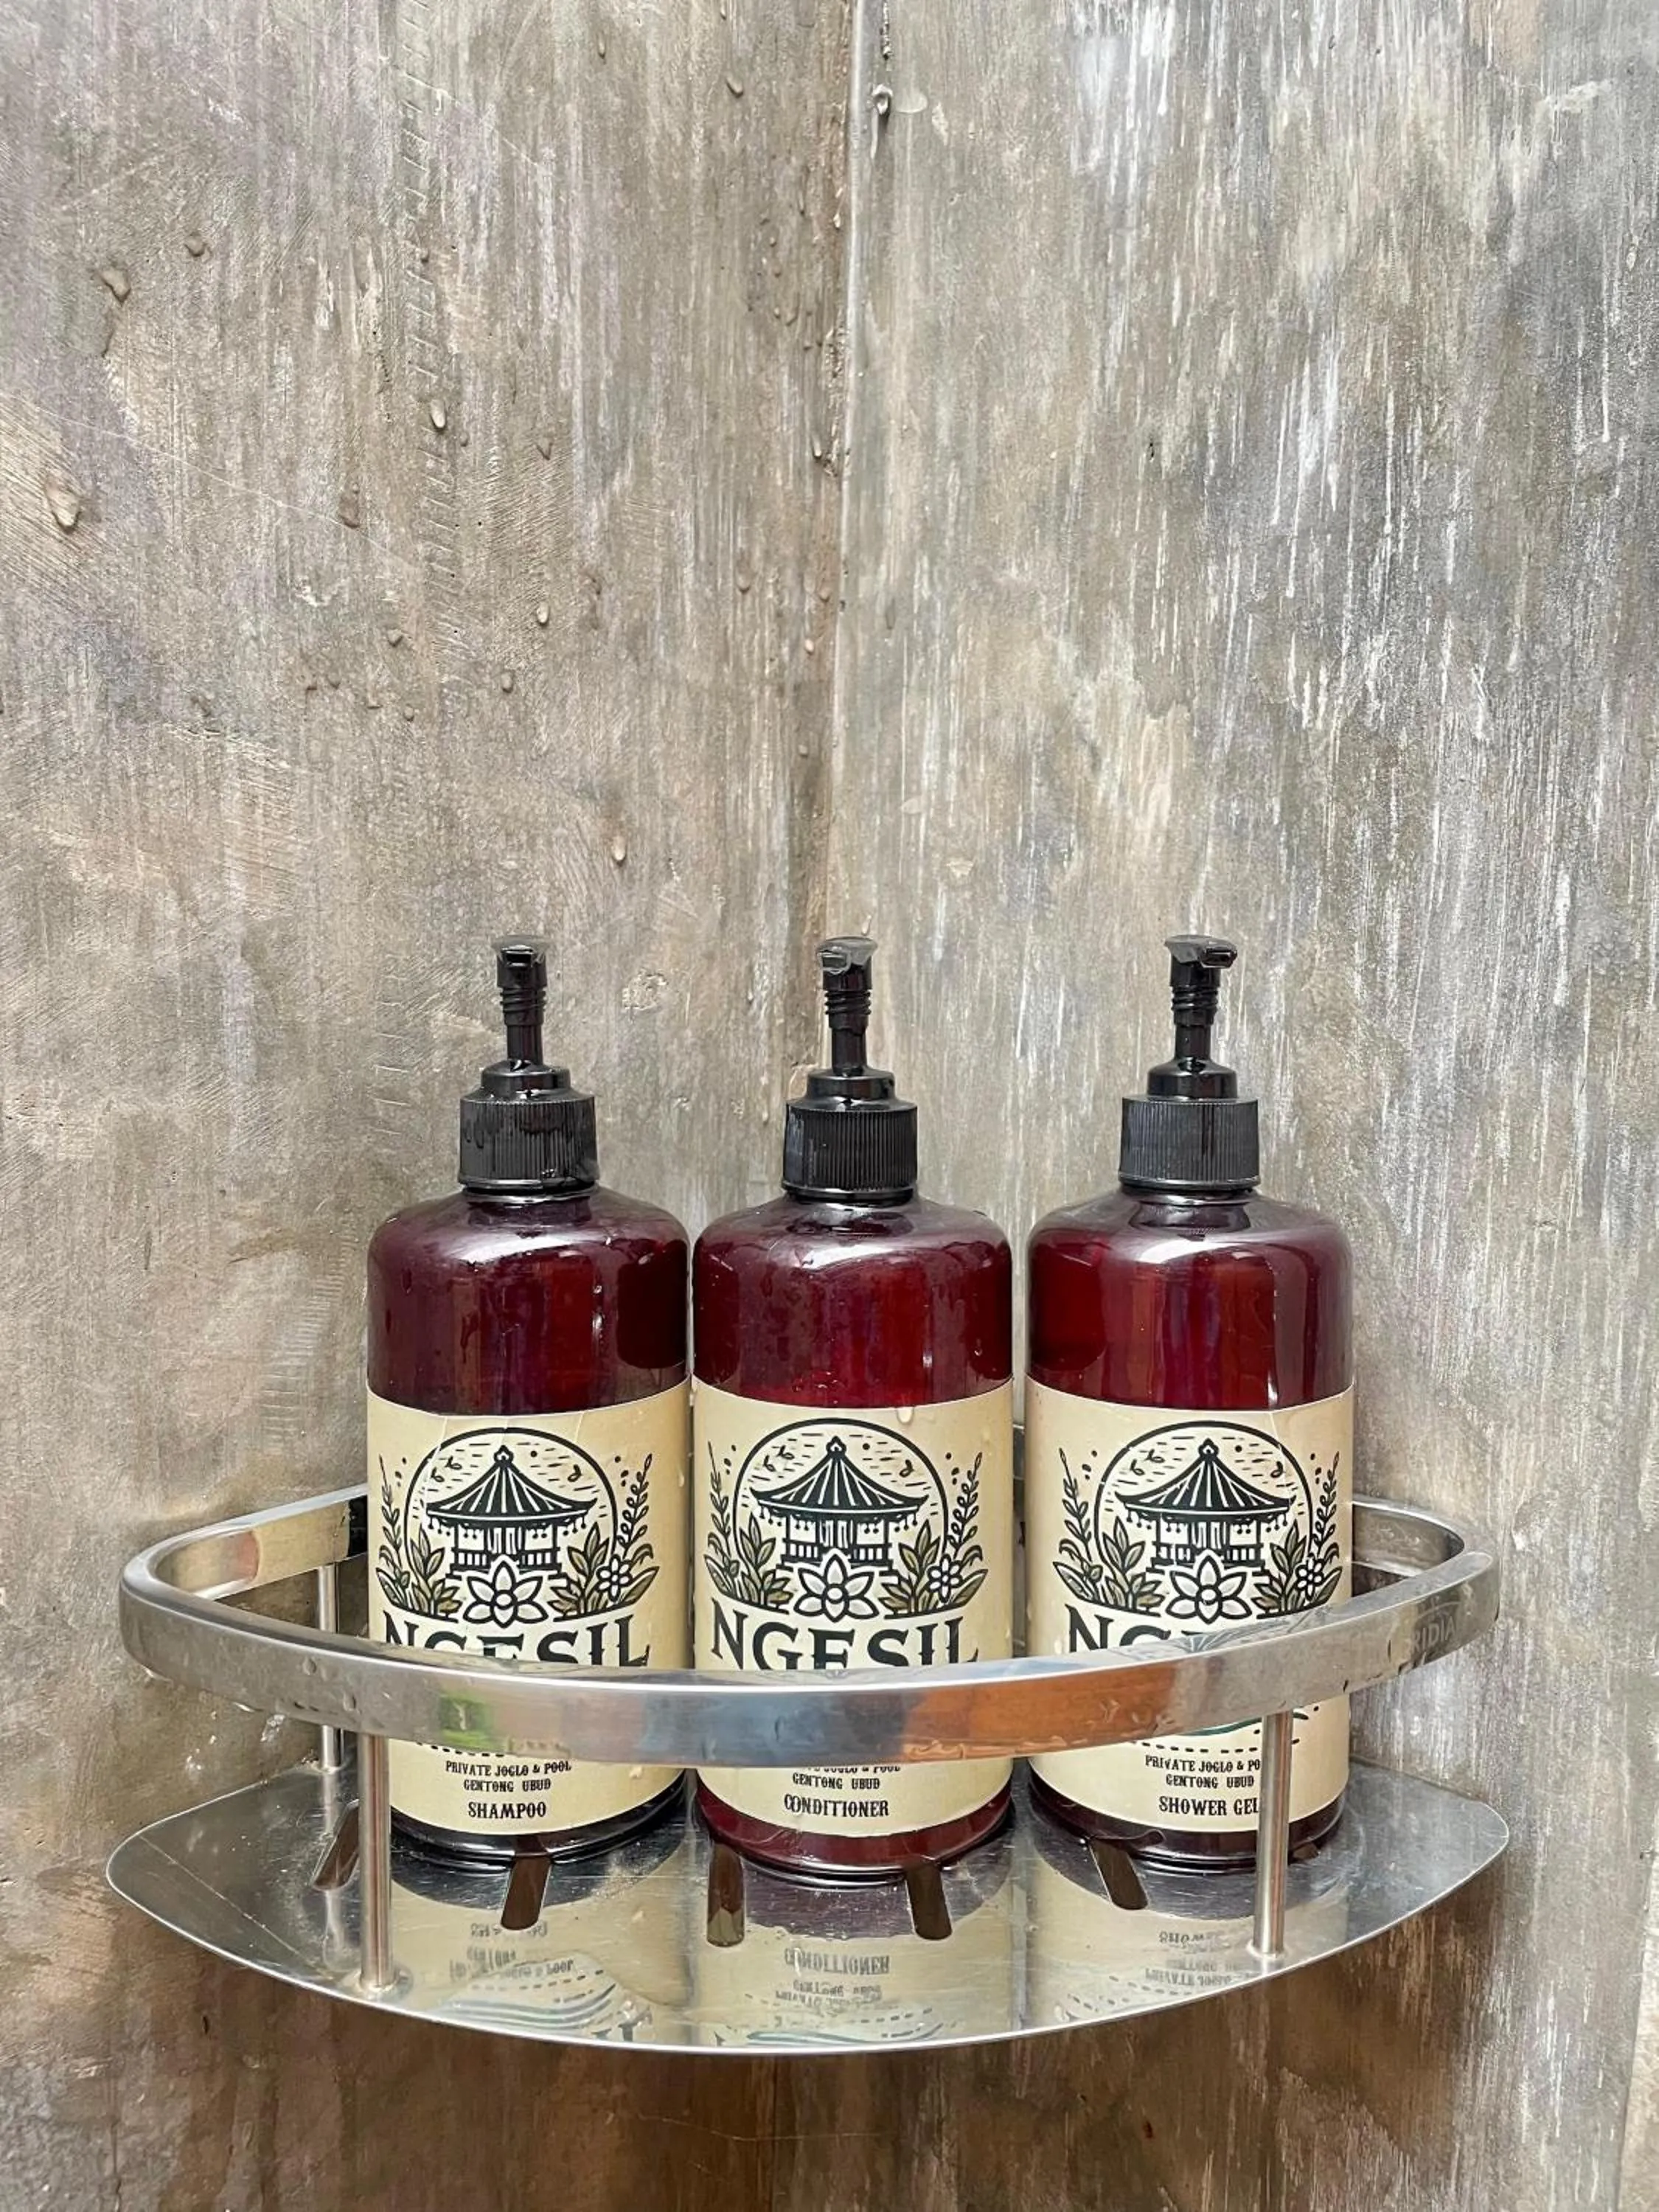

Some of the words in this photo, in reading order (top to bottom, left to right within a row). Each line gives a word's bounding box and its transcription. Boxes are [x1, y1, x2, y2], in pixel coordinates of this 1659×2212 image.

[711, 1597, 979, 1670] NGESIL
[445, 1760, 492, 1776] PRIVATE
[495, 1764, 529, 1777] JOGLO
[532, 1763, 540, 1773] &
[544, 1760, 572, 1774] POOL
[1145, 1755, 1195, 1772] PRIVATE
[1198, 1761, 1234, 1773] JOGLO
[1237, 1760, 1244, 1770] &
[1247, 1759, 1261, 1771] PO
[464, 1778, 514, 1792] GENTONG
[522, 1778, 552, 1792] UBUD
[793, 1773, 843, 1790] GENTONG
[852, 1778, 880, 1790] UBUD
[1166, 1773, 1219, 1788] GENTONG
[1226, 1775, 1254, 1788] UBUD
[468, 1801, 546, 1819] SHAMPOO
[784, 1793, 889, 1818] CONDITIONER
[1158, 1795, 1227, 1816] SHOWER
[1234, 1797, 1259, 1815] GEL
